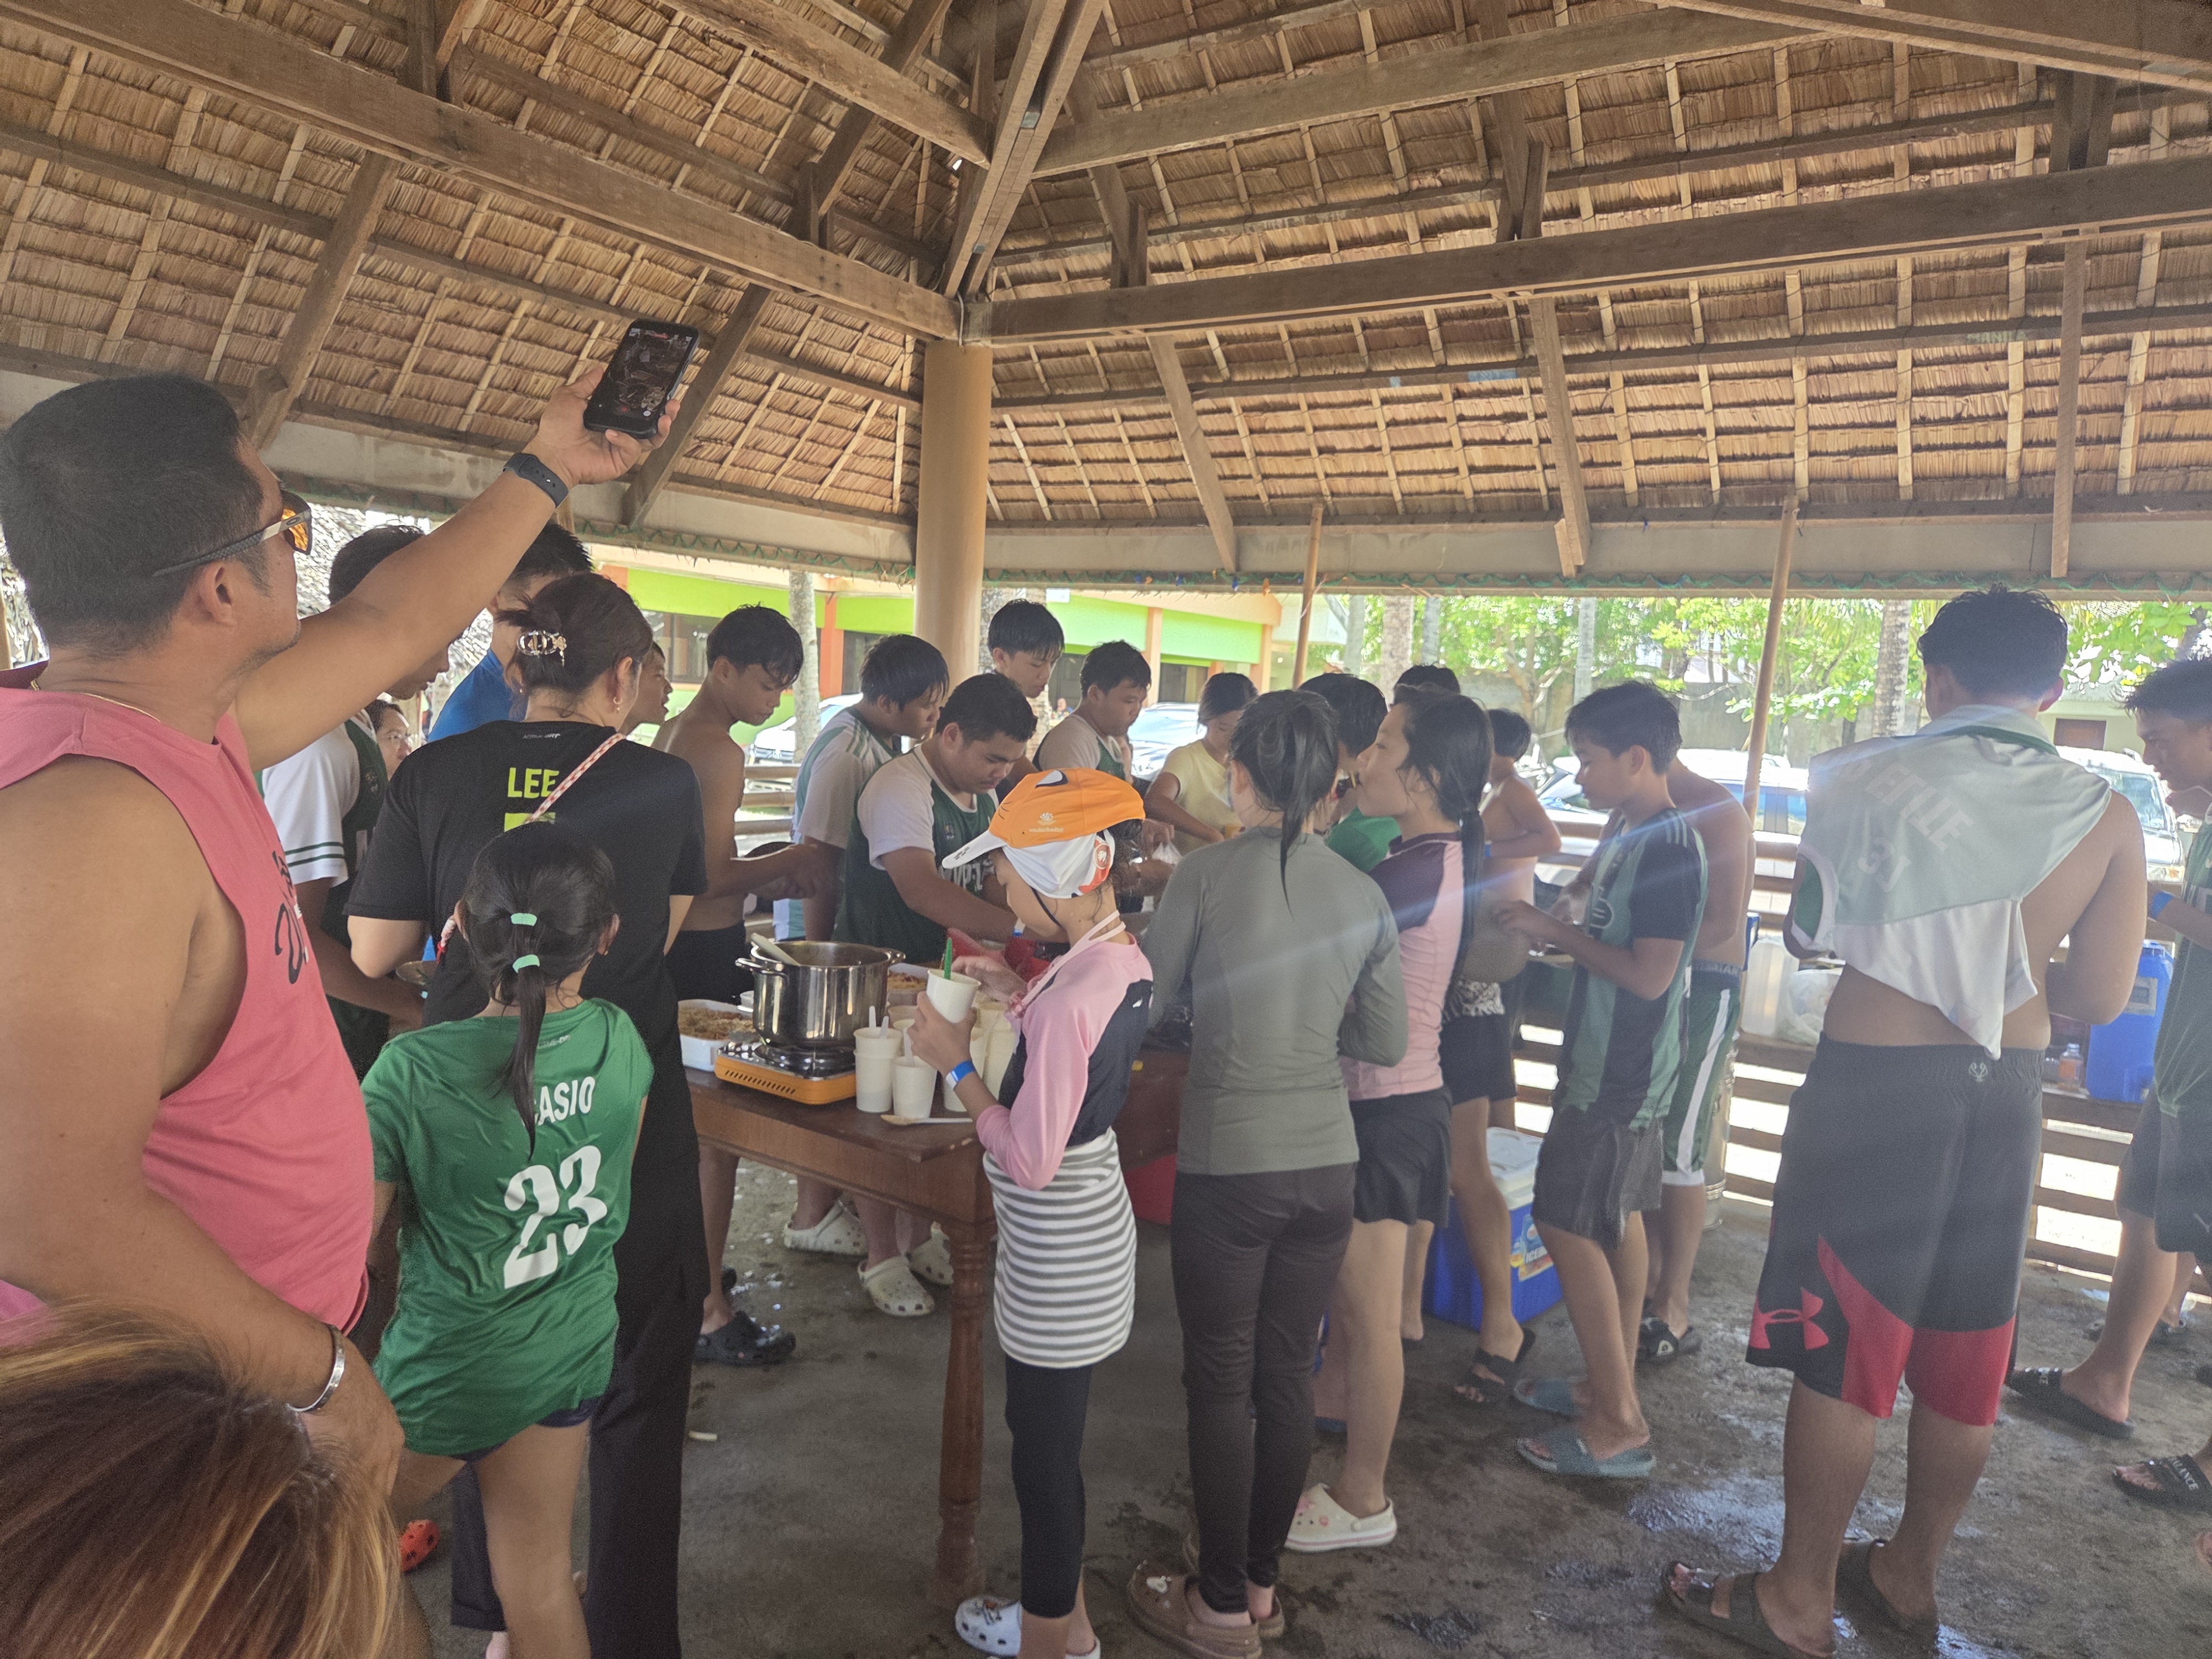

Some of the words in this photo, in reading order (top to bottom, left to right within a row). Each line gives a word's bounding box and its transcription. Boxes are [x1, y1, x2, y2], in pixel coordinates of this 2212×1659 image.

[507, 767, 560, 799] LEE
[521, 1076, 596, 1126] ASIO
[504, 1145, 608, 1289] 23
